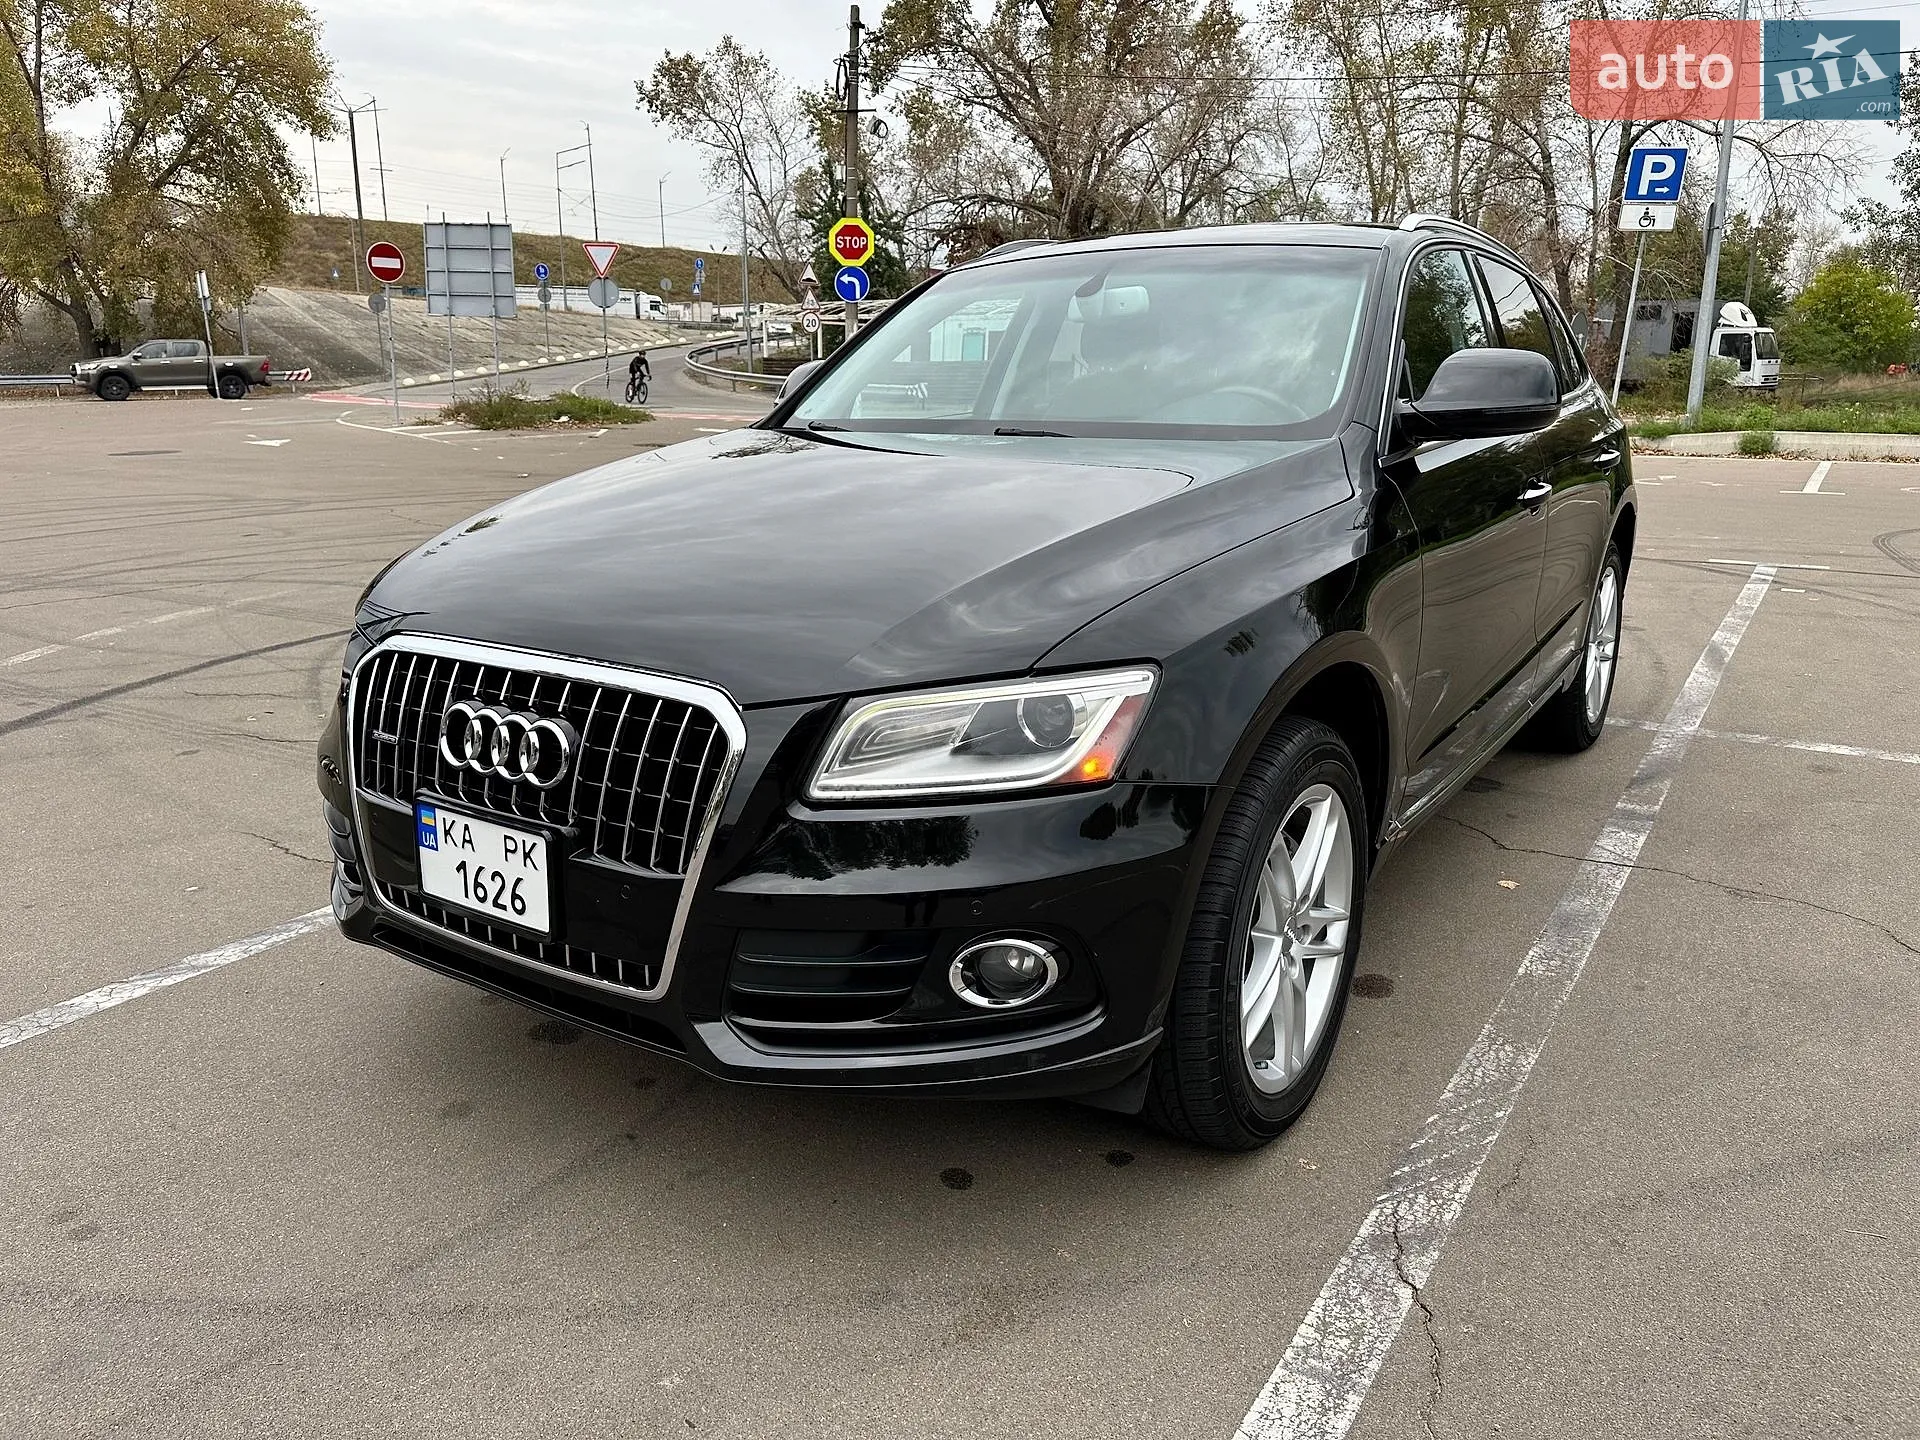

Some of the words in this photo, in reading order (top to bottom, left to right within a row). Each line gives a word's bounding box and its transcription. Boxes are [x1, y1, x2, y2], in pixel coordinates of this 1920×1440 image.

[1637, 154, 1677, 196] P
[836, 236, 868, 249] STOP
[805, 318, 817, 328] 20
[422, 831, 437, 849] UA
[442, 817, 476, 853] KA
[503, 834, 539, 871] PK
[455, 860, 527, 916] 1626
